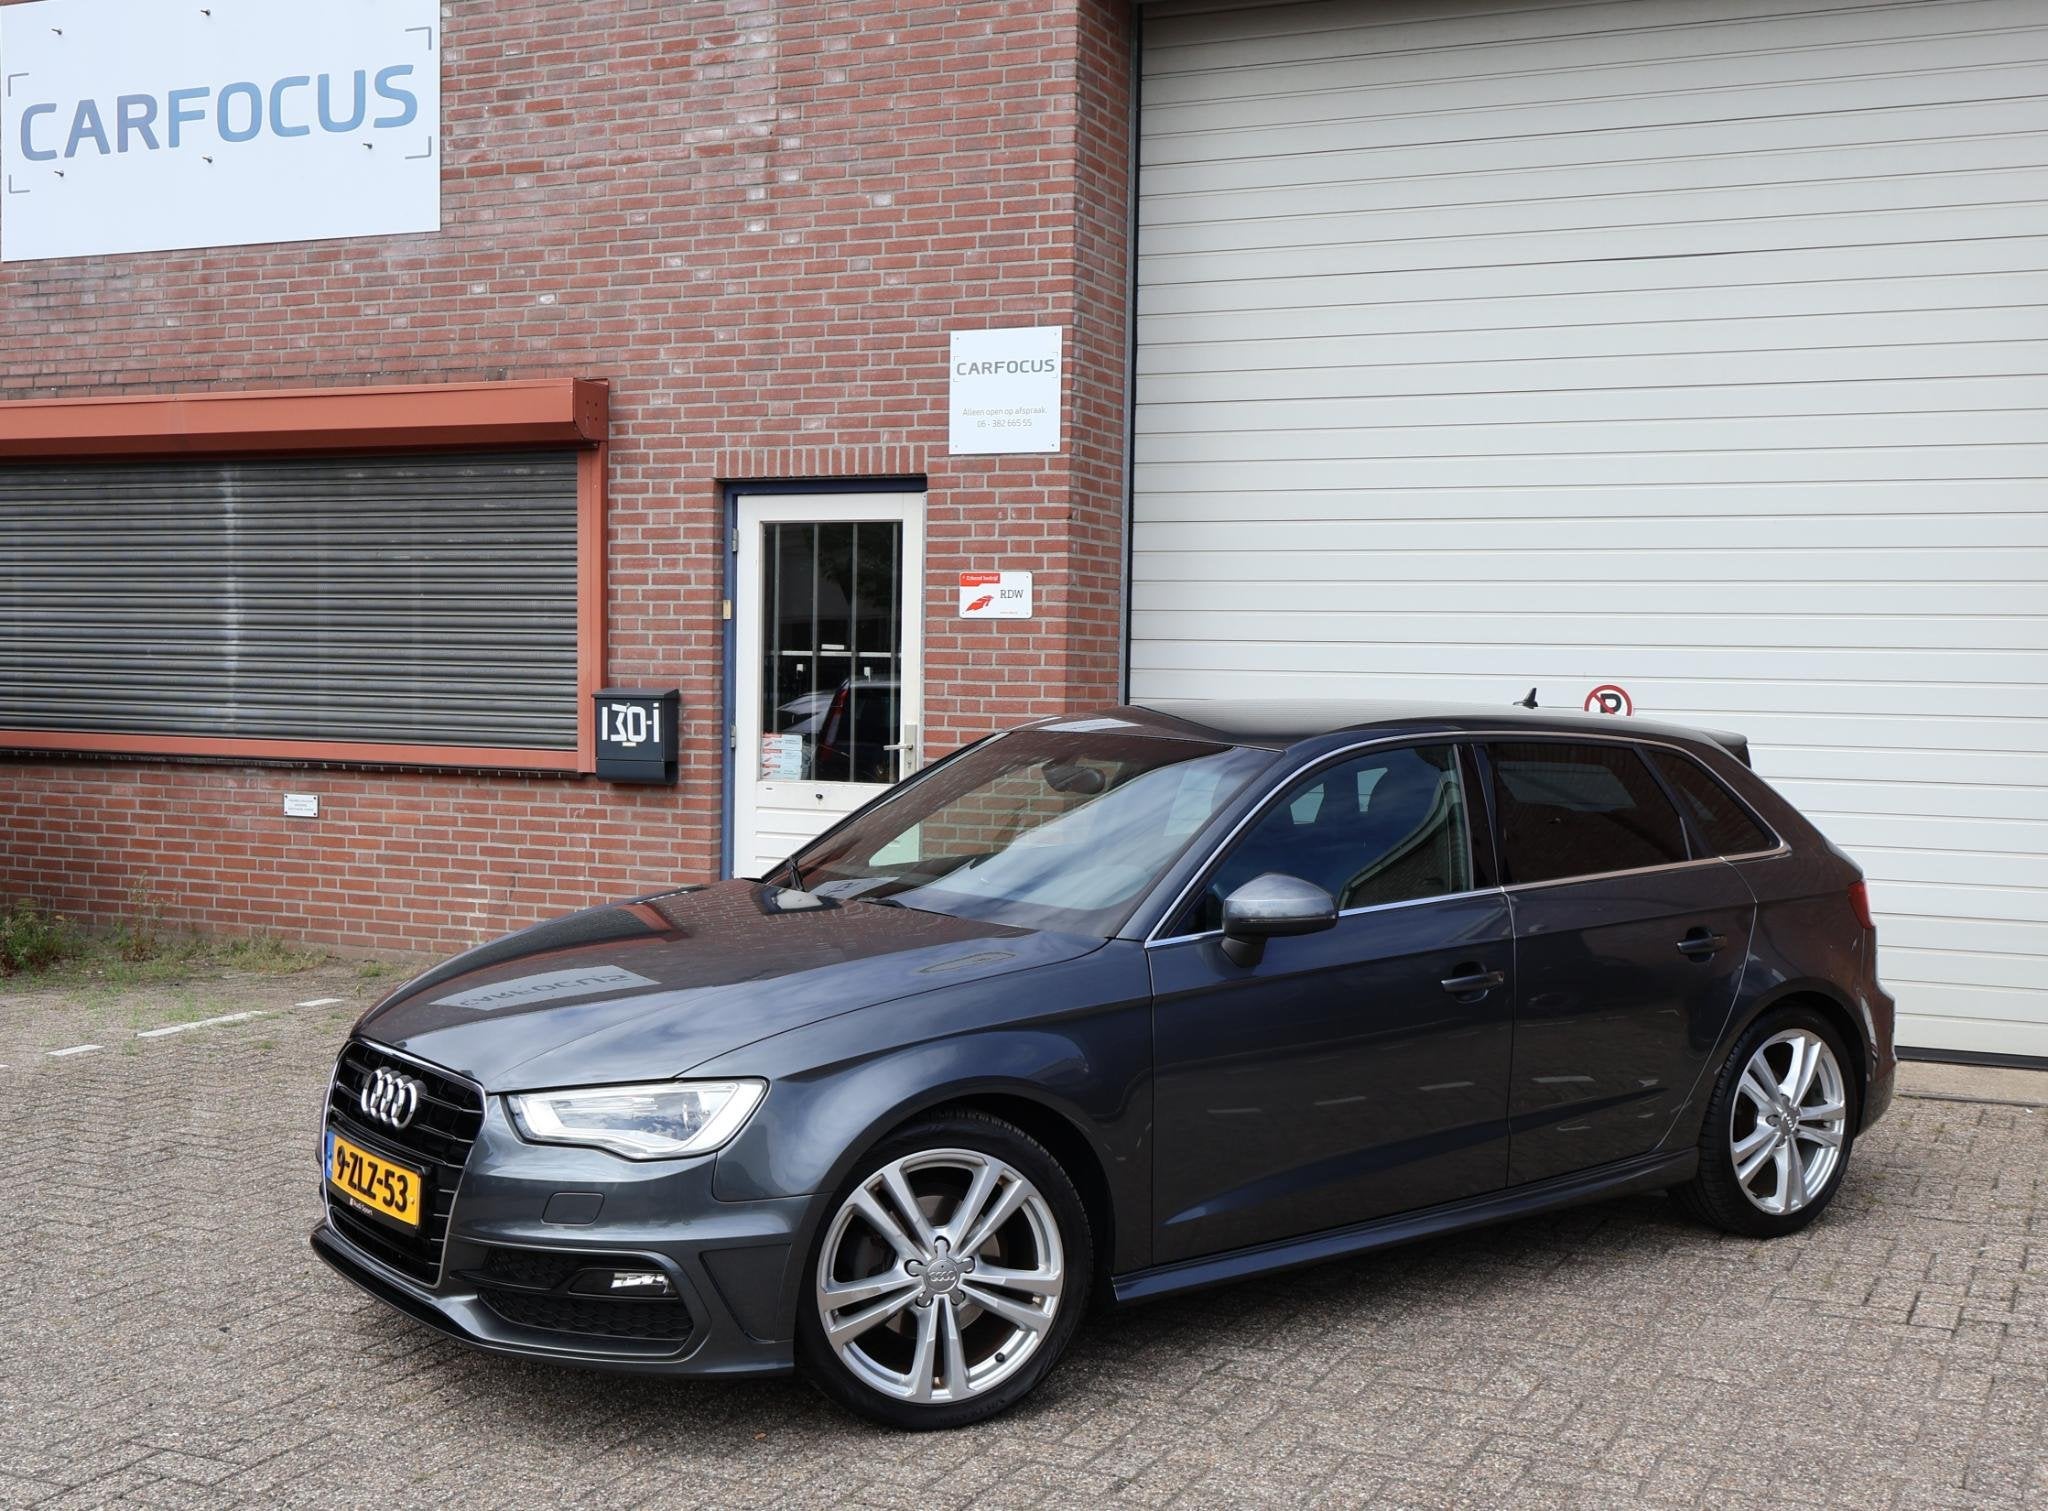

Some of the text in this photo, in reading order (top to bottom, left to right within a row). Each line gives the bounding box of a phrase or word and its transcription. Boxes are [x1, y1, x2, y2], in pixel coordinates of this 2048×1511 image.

[20, 64, 418, 161] CARFOCUS
[956, 358, 1055, 376] CARFOCUS
[962, 407, 984, 416] Alleen
[985, 408, 1003, 417] open
[1004, 408, 1014, 416] op
[991, 419, 1006, 428] 382
[999, 589, 1024, 599] RDW
[336, 1144, 409, 1213] 9-ZLZ-53
